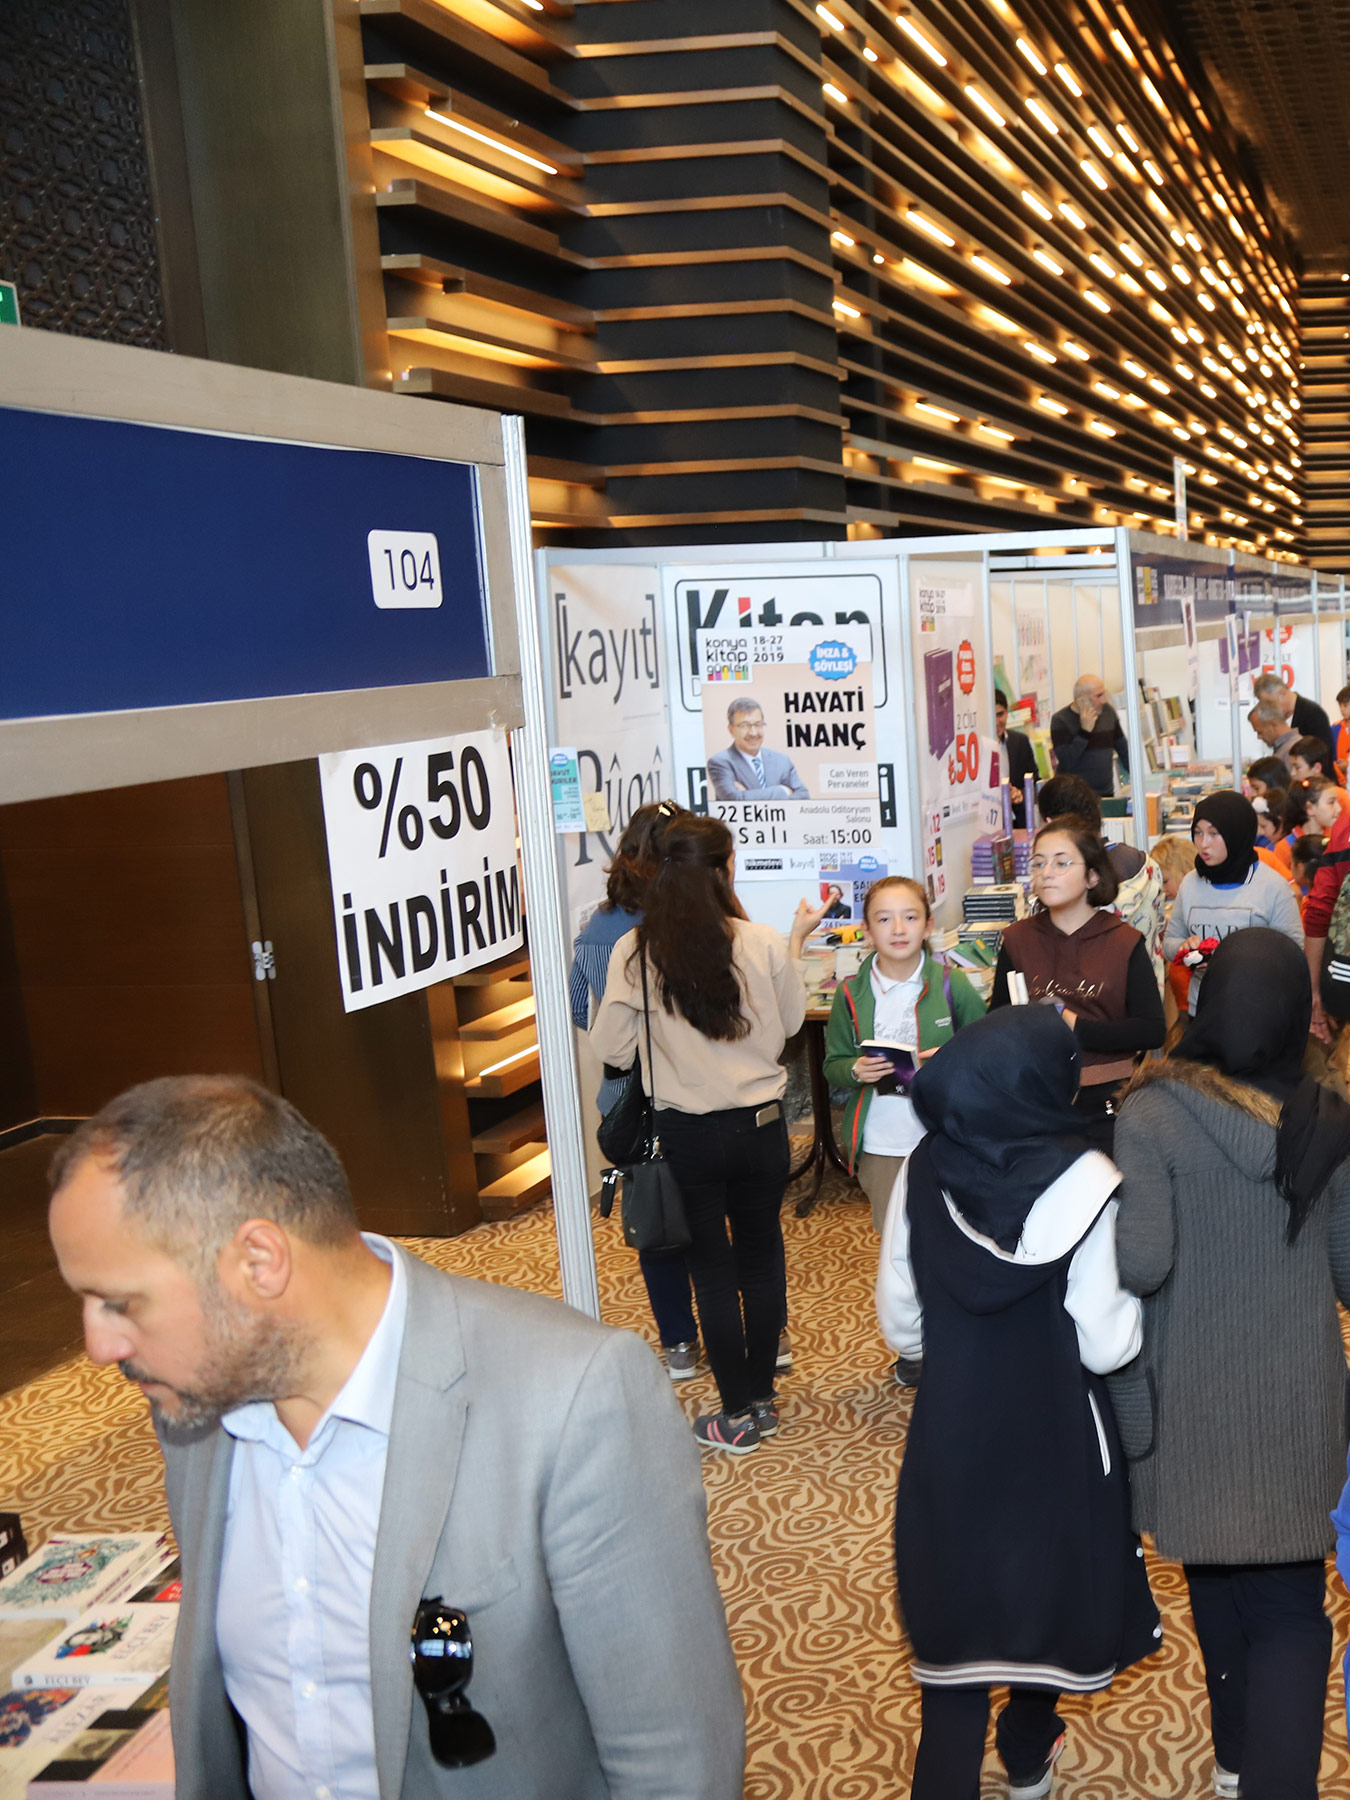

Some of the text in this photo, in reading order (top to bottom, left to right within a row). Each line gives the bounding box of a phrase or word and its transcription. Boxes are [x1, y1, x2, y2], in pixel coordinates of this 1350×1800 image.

[383, 549, 435, 592] 104
[706, 635, 784, 651] konya 18-27
[706, 649, 784, 664] kitap 2019
[816, 647, 840, 658] İMZA
[813, 658, 853, 672] SÖYLEŞİ
[784, 686, 864, 713] HAYATİ
[956, 714, 962, 730] 2
[786, 719, 866, 751] İNANÇ
[829, 769, 869, 778] Can Veren
[828, 780, 870, 788] Pervaneler
[353, 745, 491, 858] %50
[718, 804, 786, 823] 22 Ekim
[800, 805, 871, 816] Anadolu Oditoryum
[846, 815, 871, 823] Salonu
[803, 829, 872, 844] Saat: 15:00
[342, 856, 522, 993] İNDİRİM
